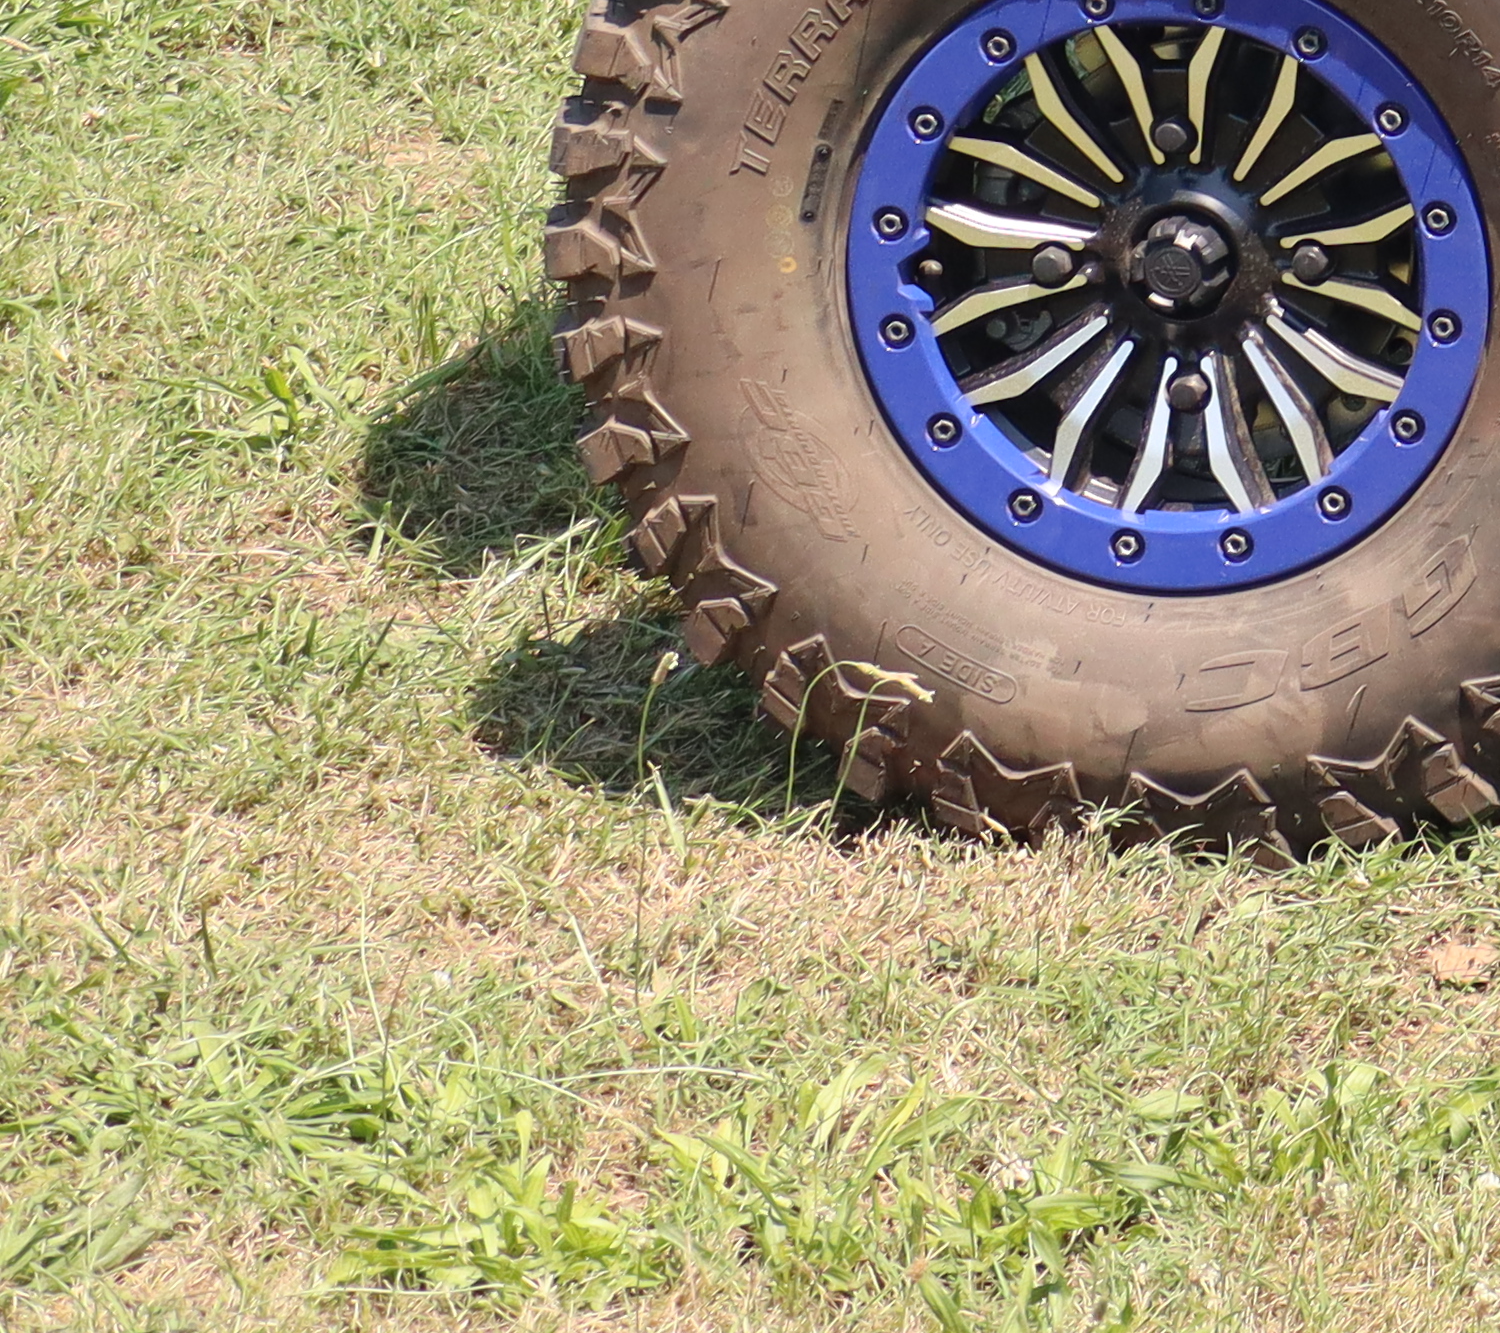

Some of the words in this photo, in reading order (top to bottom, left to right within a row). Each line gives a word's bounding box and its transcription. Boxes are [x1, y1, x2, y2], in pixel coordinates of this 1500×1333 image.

[904, 506, 950, 546] ONLY
[950, 547, 992, 577] USE
[1086, 604, 1126, 628] FOR
[1184, 534, 1479, 711] GBC
[918, 640, 936, 658] A
[941, 656, 1000, 694] SIDE
